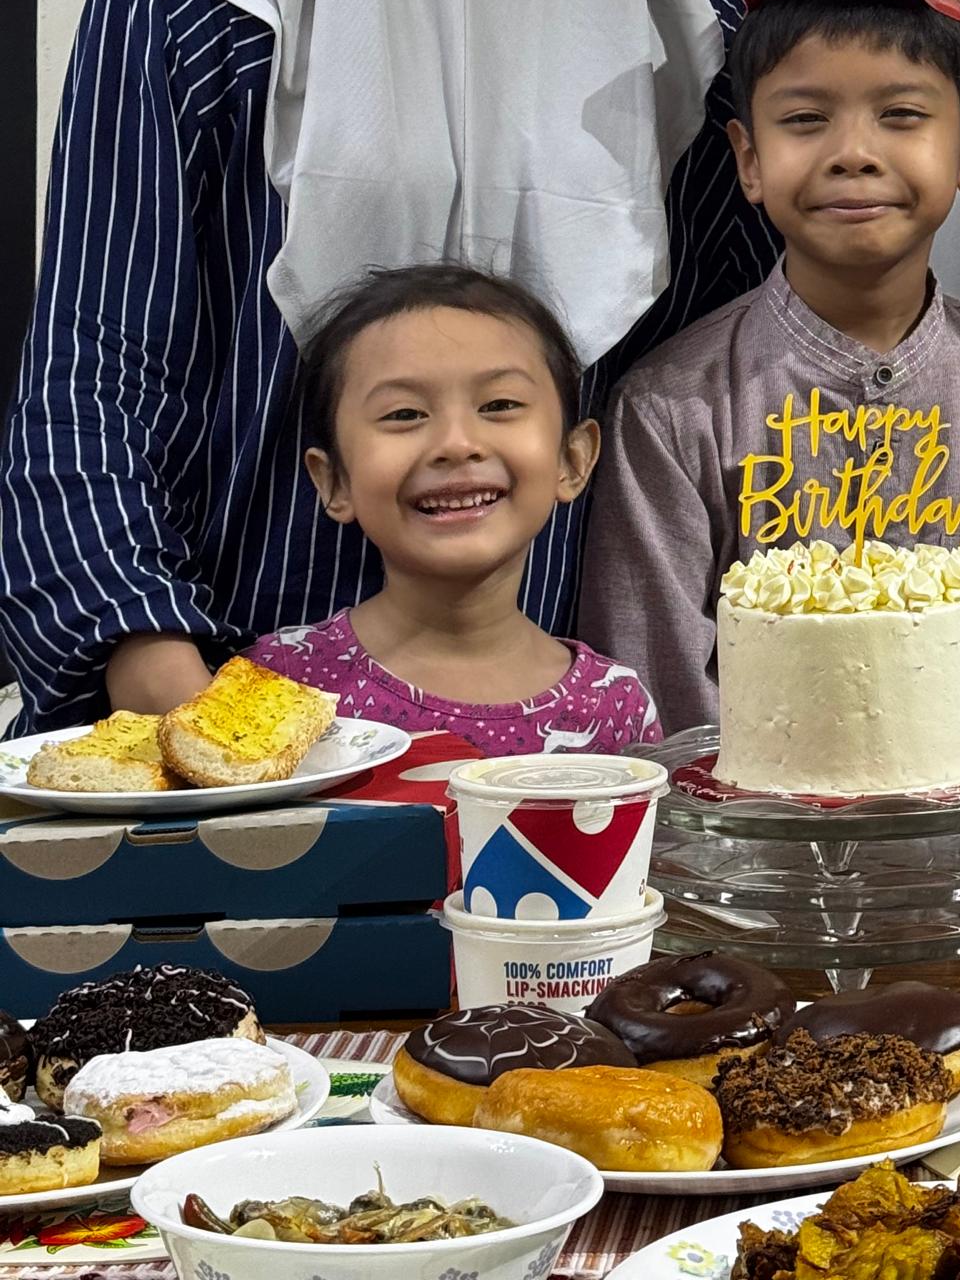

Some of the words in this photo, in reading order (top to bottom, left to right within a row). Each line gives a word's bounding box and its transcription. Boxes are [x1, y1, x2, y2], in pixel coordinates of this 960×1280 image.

[766, 387, 951, 459] Happy
[504, 961, 541, 979] 100%
[546, 957, 614, 979] COMFORT
[506, 977, 613, 998] LIP-SMACKIN
